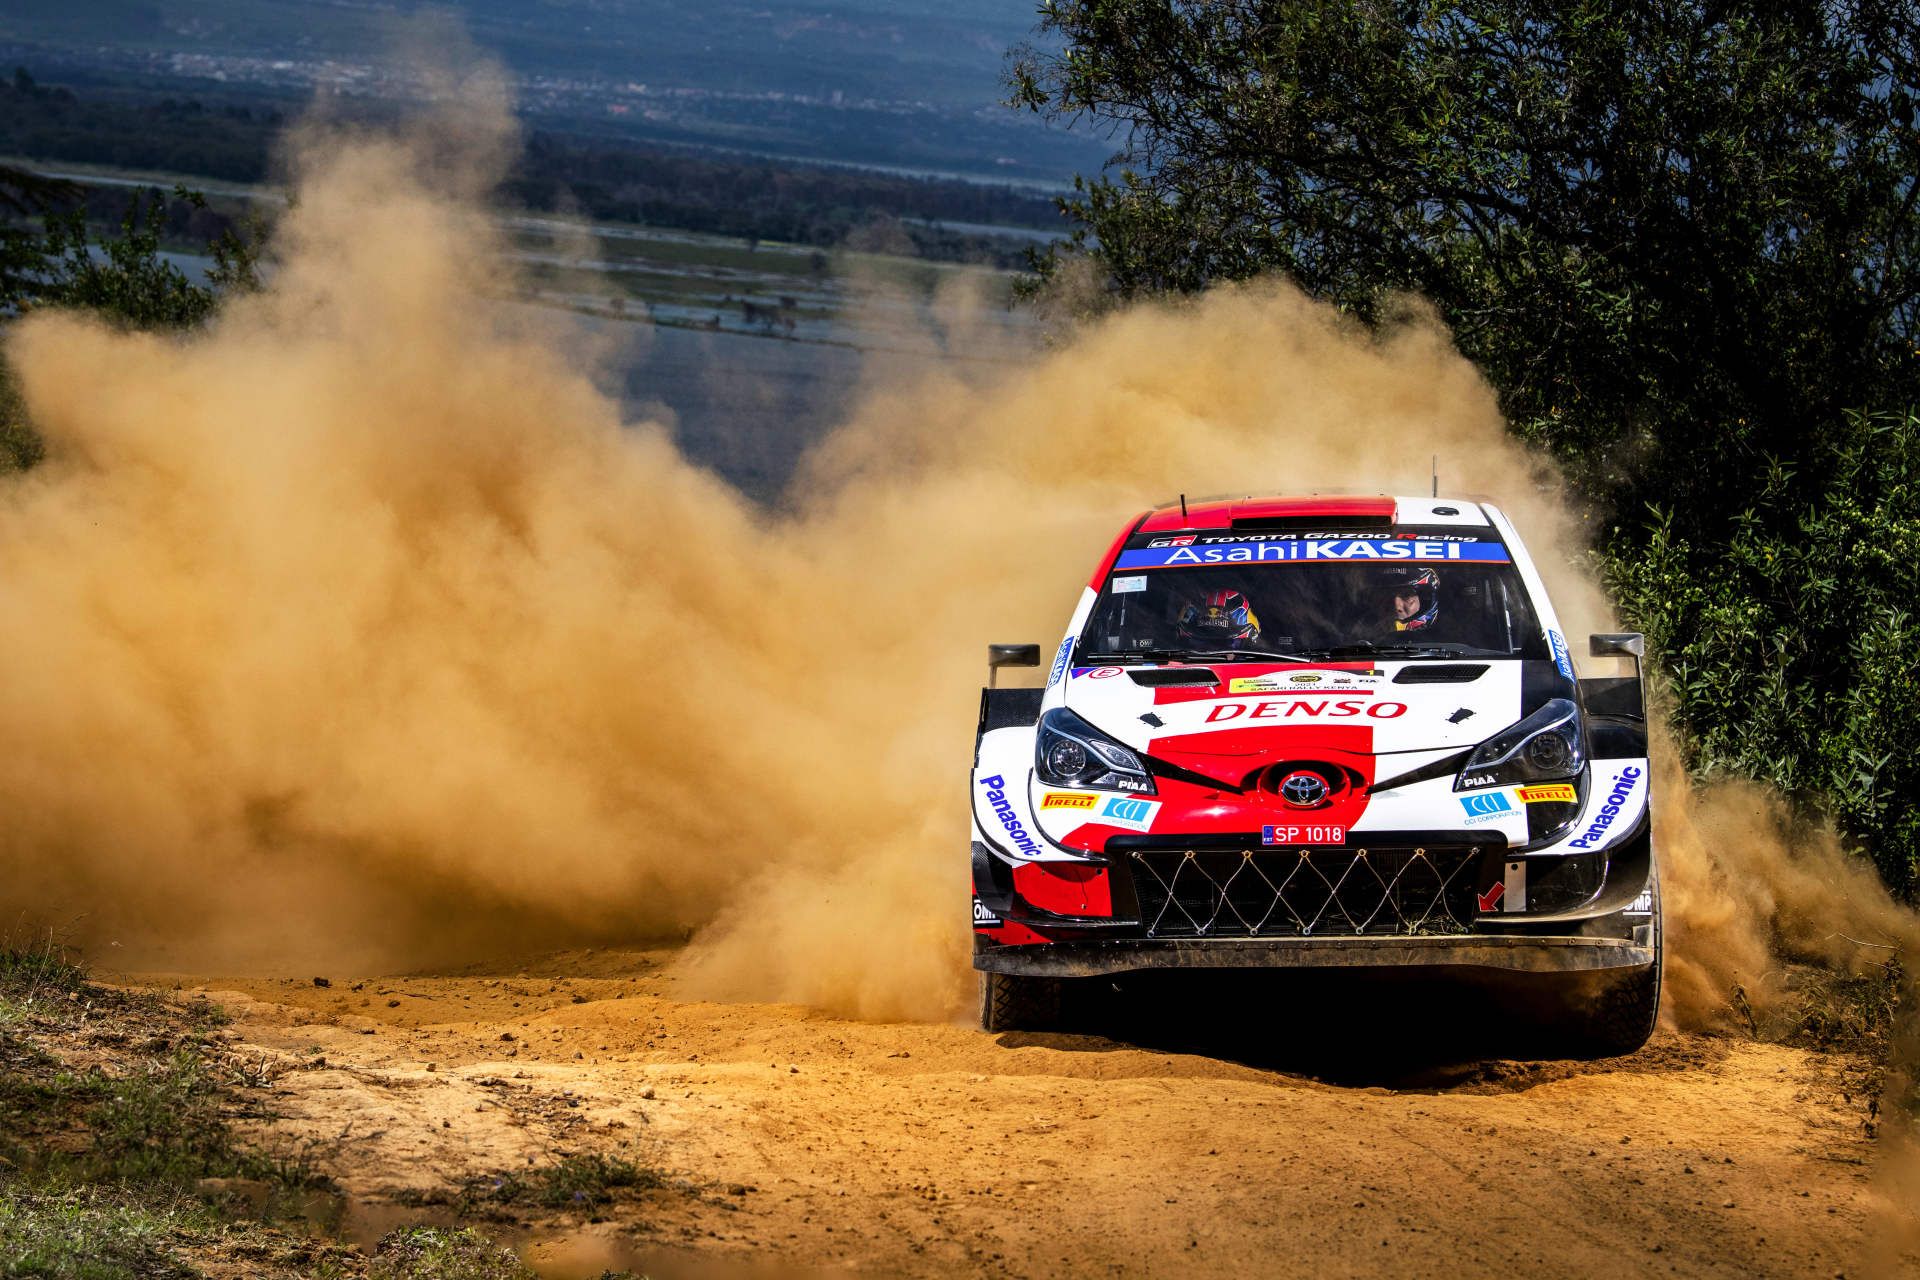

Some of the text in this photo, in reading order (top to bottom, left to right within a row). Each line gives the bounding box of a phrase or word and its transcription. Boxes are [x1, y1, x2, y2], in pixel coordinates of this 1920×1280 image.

[1201, 534, 1297, 544] TOYOTA
[1396, 533, 1478, 543] Racing
[1204, 701, 1408, 724] DENSO
[1118, 780, 1148, 792] PIAA
[1463, 774, 1496, 788] PIAA
[1044, 794, 1096, 807] PIRELLI
[1519, 786, 1574, 801] PIRELLI
[979, 774, 1043, 856] Panasonic
[1567, 766, 1641, 849] Panasonic
[1275, 827, 1342, 843] SP 1018
